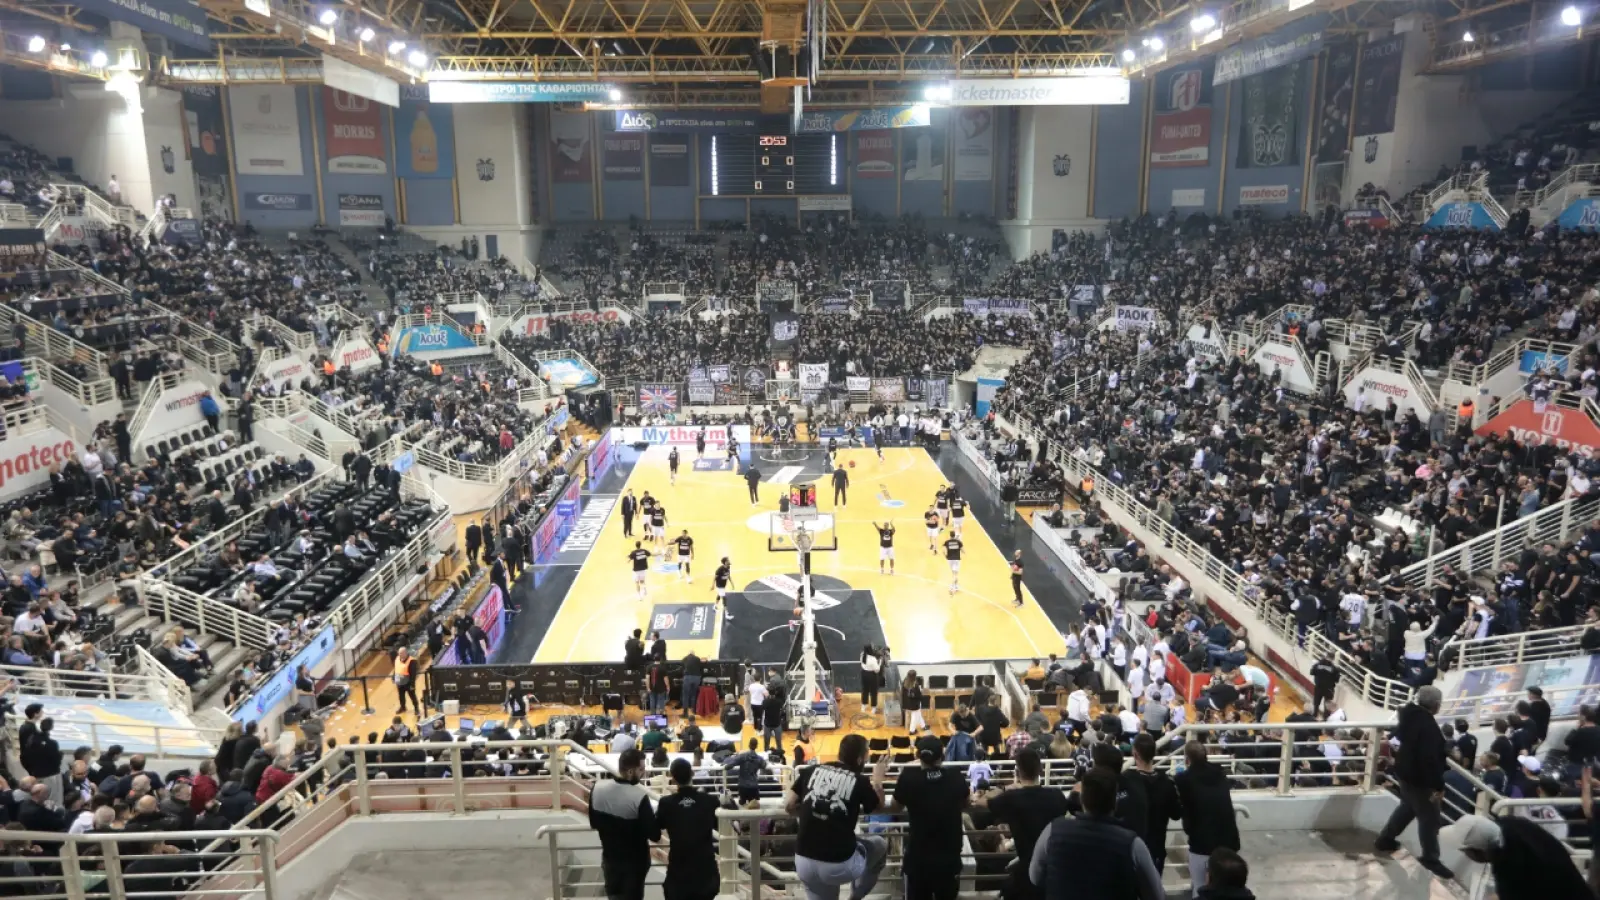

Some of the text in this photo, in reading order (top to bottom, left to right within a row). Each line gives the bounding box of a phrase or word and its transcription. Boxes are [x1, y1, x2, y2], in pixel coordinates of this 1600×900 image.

[621, 112, 651, 130] Διός
[333, 124, 376, 139] MORRIS
[340, 195, 381, 206] KYANA
[1241, 187, 1288, 199] mateco
[1117, 308, 1149, 322] PAOK
[1261, 351, 1295, 367] winmasters
[1362, 377, 1409, 399] winmasters
[642, 428, 726, 444] Mythem
[1348, 602, 1359, 613] 20
